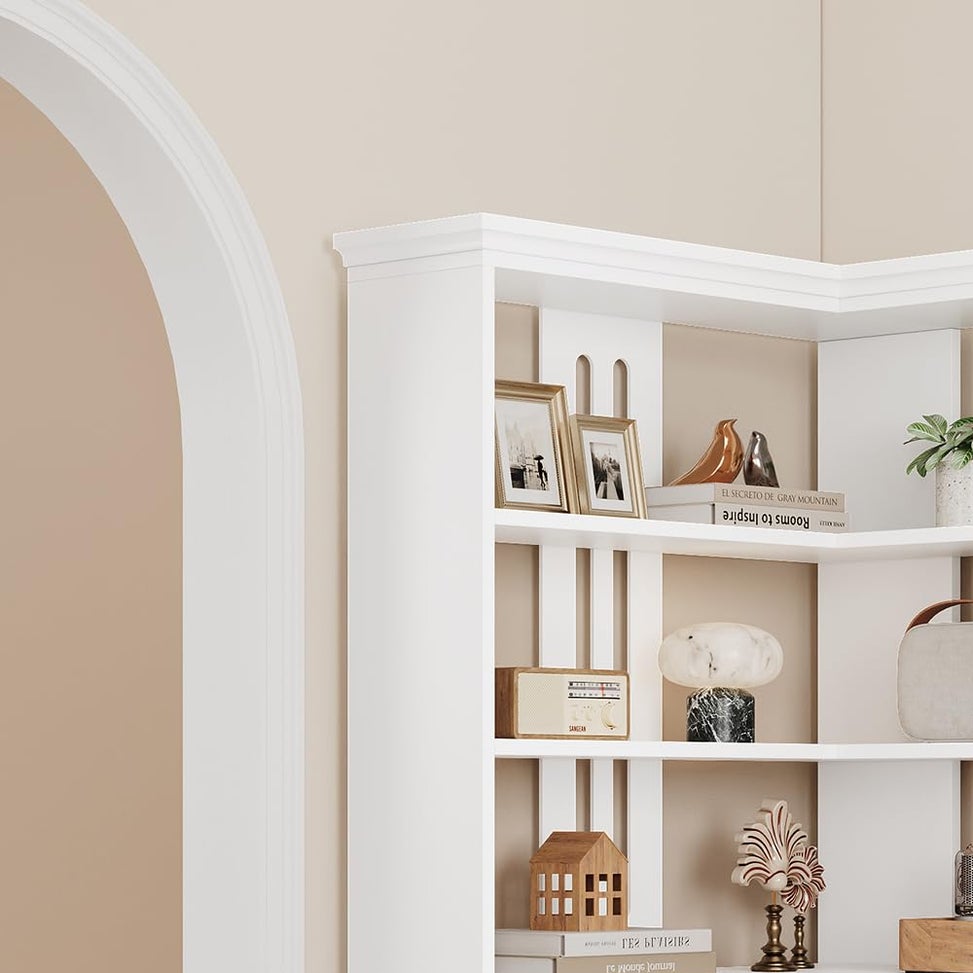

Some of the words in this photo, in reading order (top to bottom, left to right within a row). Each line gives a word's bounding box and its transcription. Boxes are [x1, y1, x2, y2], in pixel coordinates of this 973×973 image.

[722, 488, 731, 497] EL
[731, 489, 762, 500] SECRETO
[764, 492, 774, 501] DE
[777, 493, 796, 503] GRAY
[797, 496, 838, 506] MOUNTAIN
[723, 508, 760, 525] Inspire
[761, 512, 773, 524] to
[775, 514, 810, 529] Rooms
